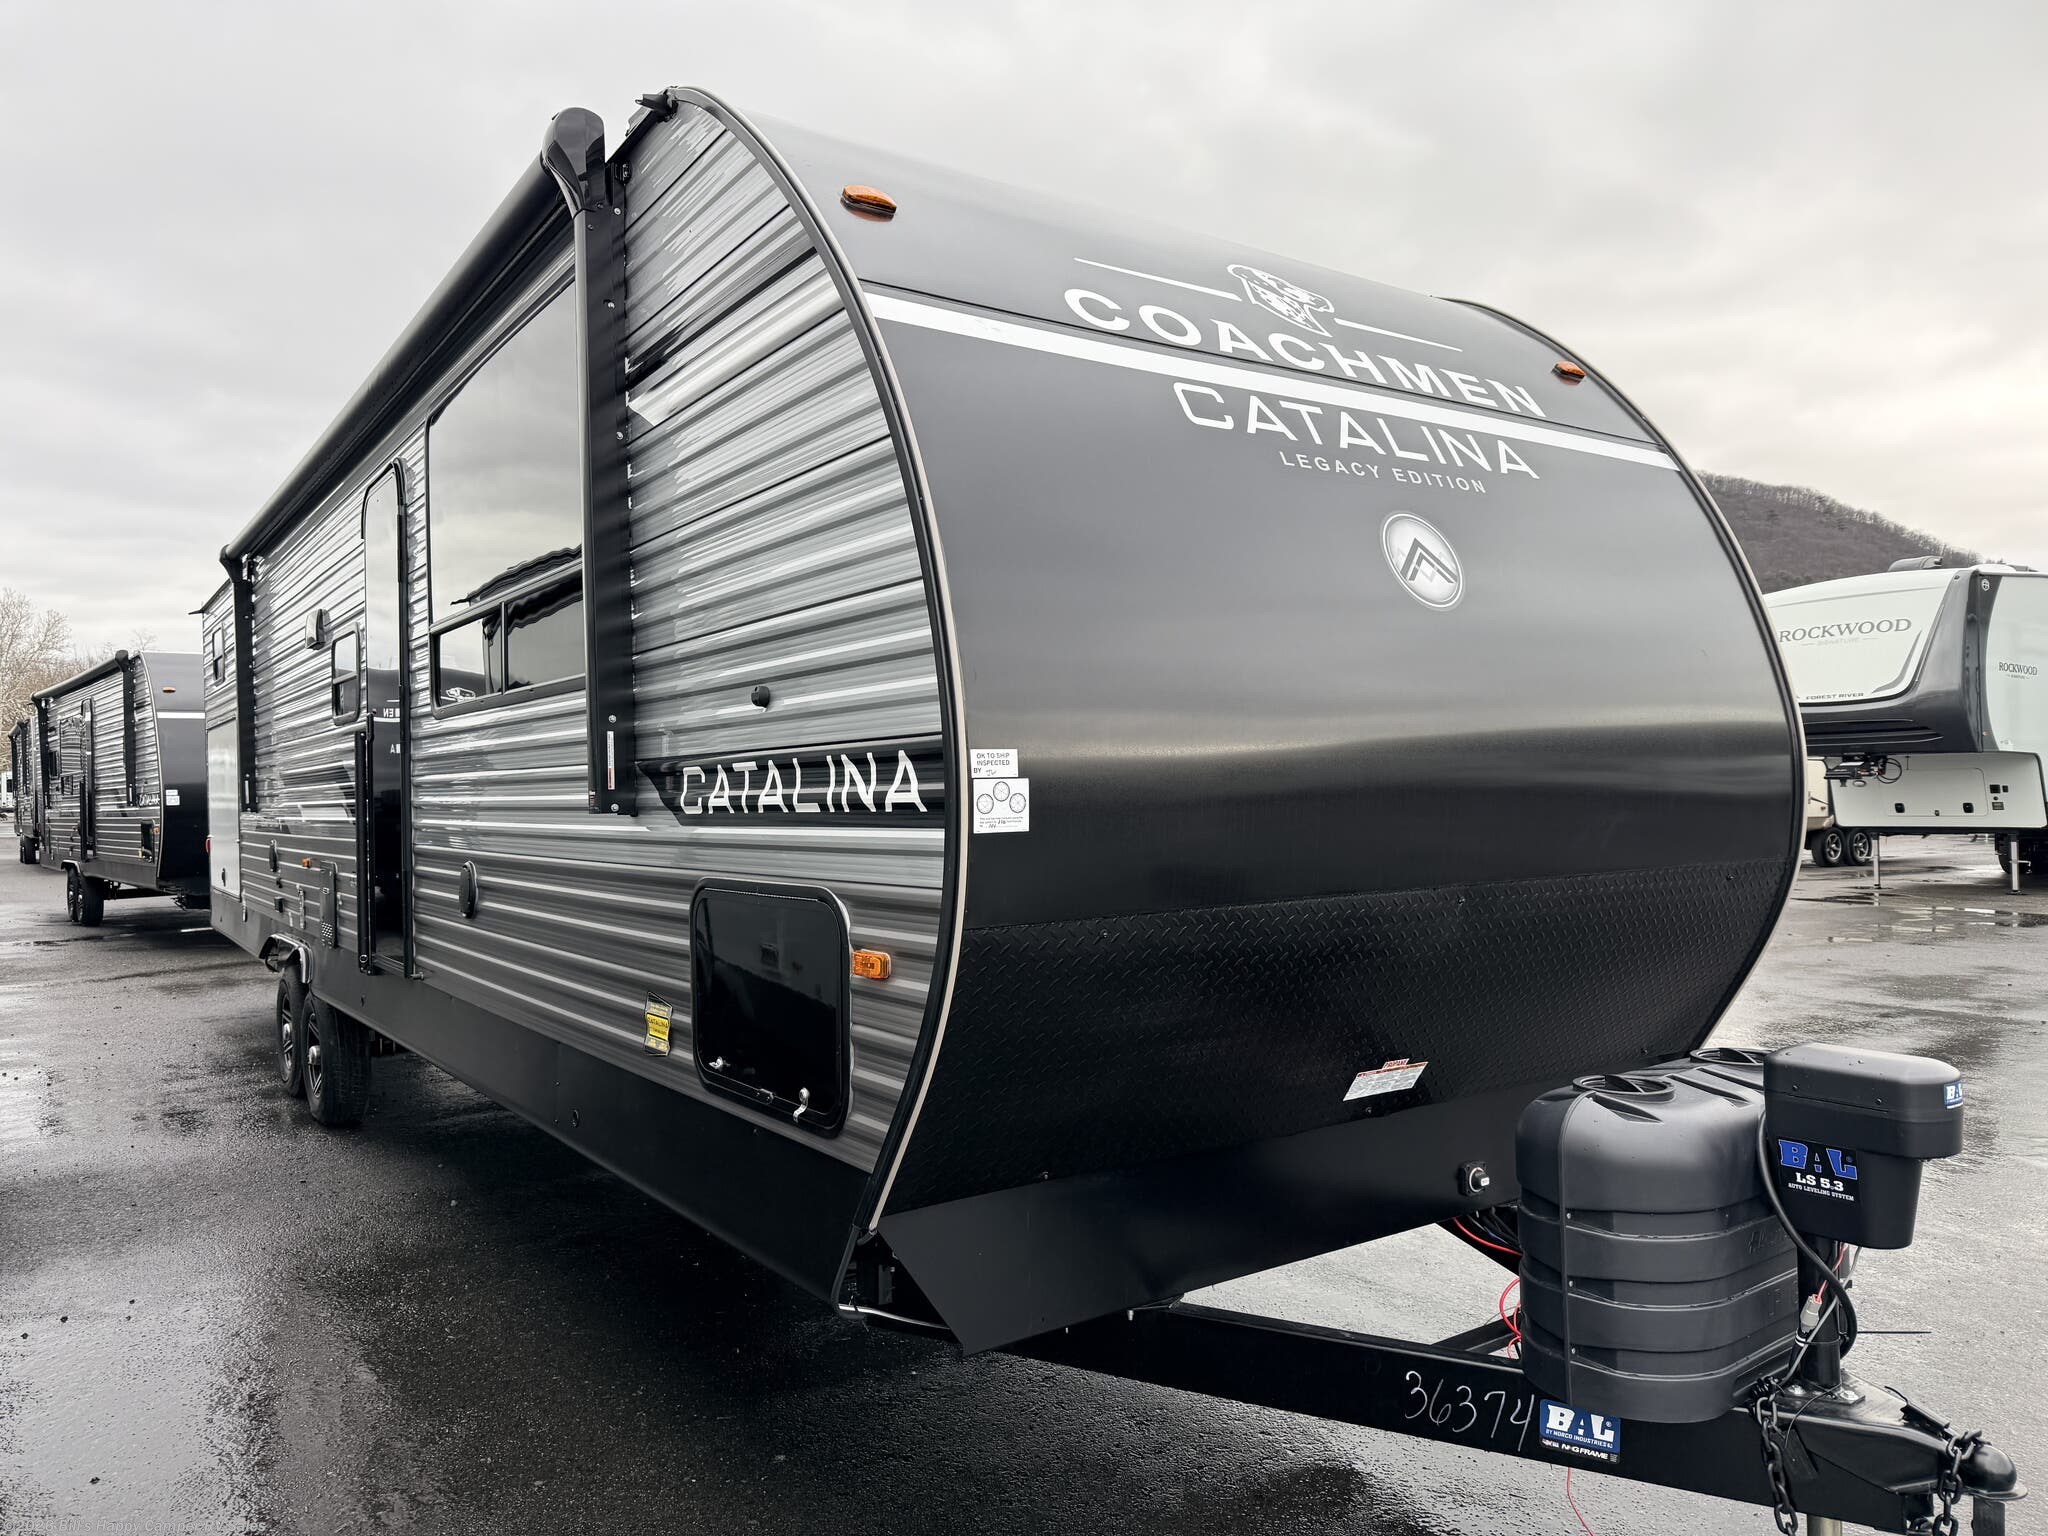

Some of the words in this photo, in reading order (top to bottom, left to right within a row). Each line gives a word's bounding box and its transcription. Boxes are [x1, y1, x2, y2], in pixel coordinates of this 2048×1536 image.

[1064, 288, 1546, 417] COACHMEN
[1173, 382, 1540, 479] CATALINA
[1279, 451, 1380, 480] LEGACY
[1392, 468, 1486, 494] EDITION
[1779, 618, 1912, 643] ROCKWOOD
[1998, 662, 2038, 676] ROCKWOOD
[680, 749, 929, 815] CATALINA
[1778, 1139, 1857, 1180] BAL
[1788, 1182, 1803, 1190] AUTO
[1803, 1185, 1831, 1196] LEVELING
[1832, 1191, 1855, 1201] SYSTEM
[1795, 1172, 1817, 1186] LS
[1820, 1177, 1844, 1192] 5.3
[1404, 1370, 1535, 1452] 36374
[1546, 1404, 1615, 1442] BAL
[1553, 1430, 1573, 1439] NORCO
[1573, 1434, 1607, 1448] INDUSTRIES
[1580, 1447, 1608, 1459] FRAME
